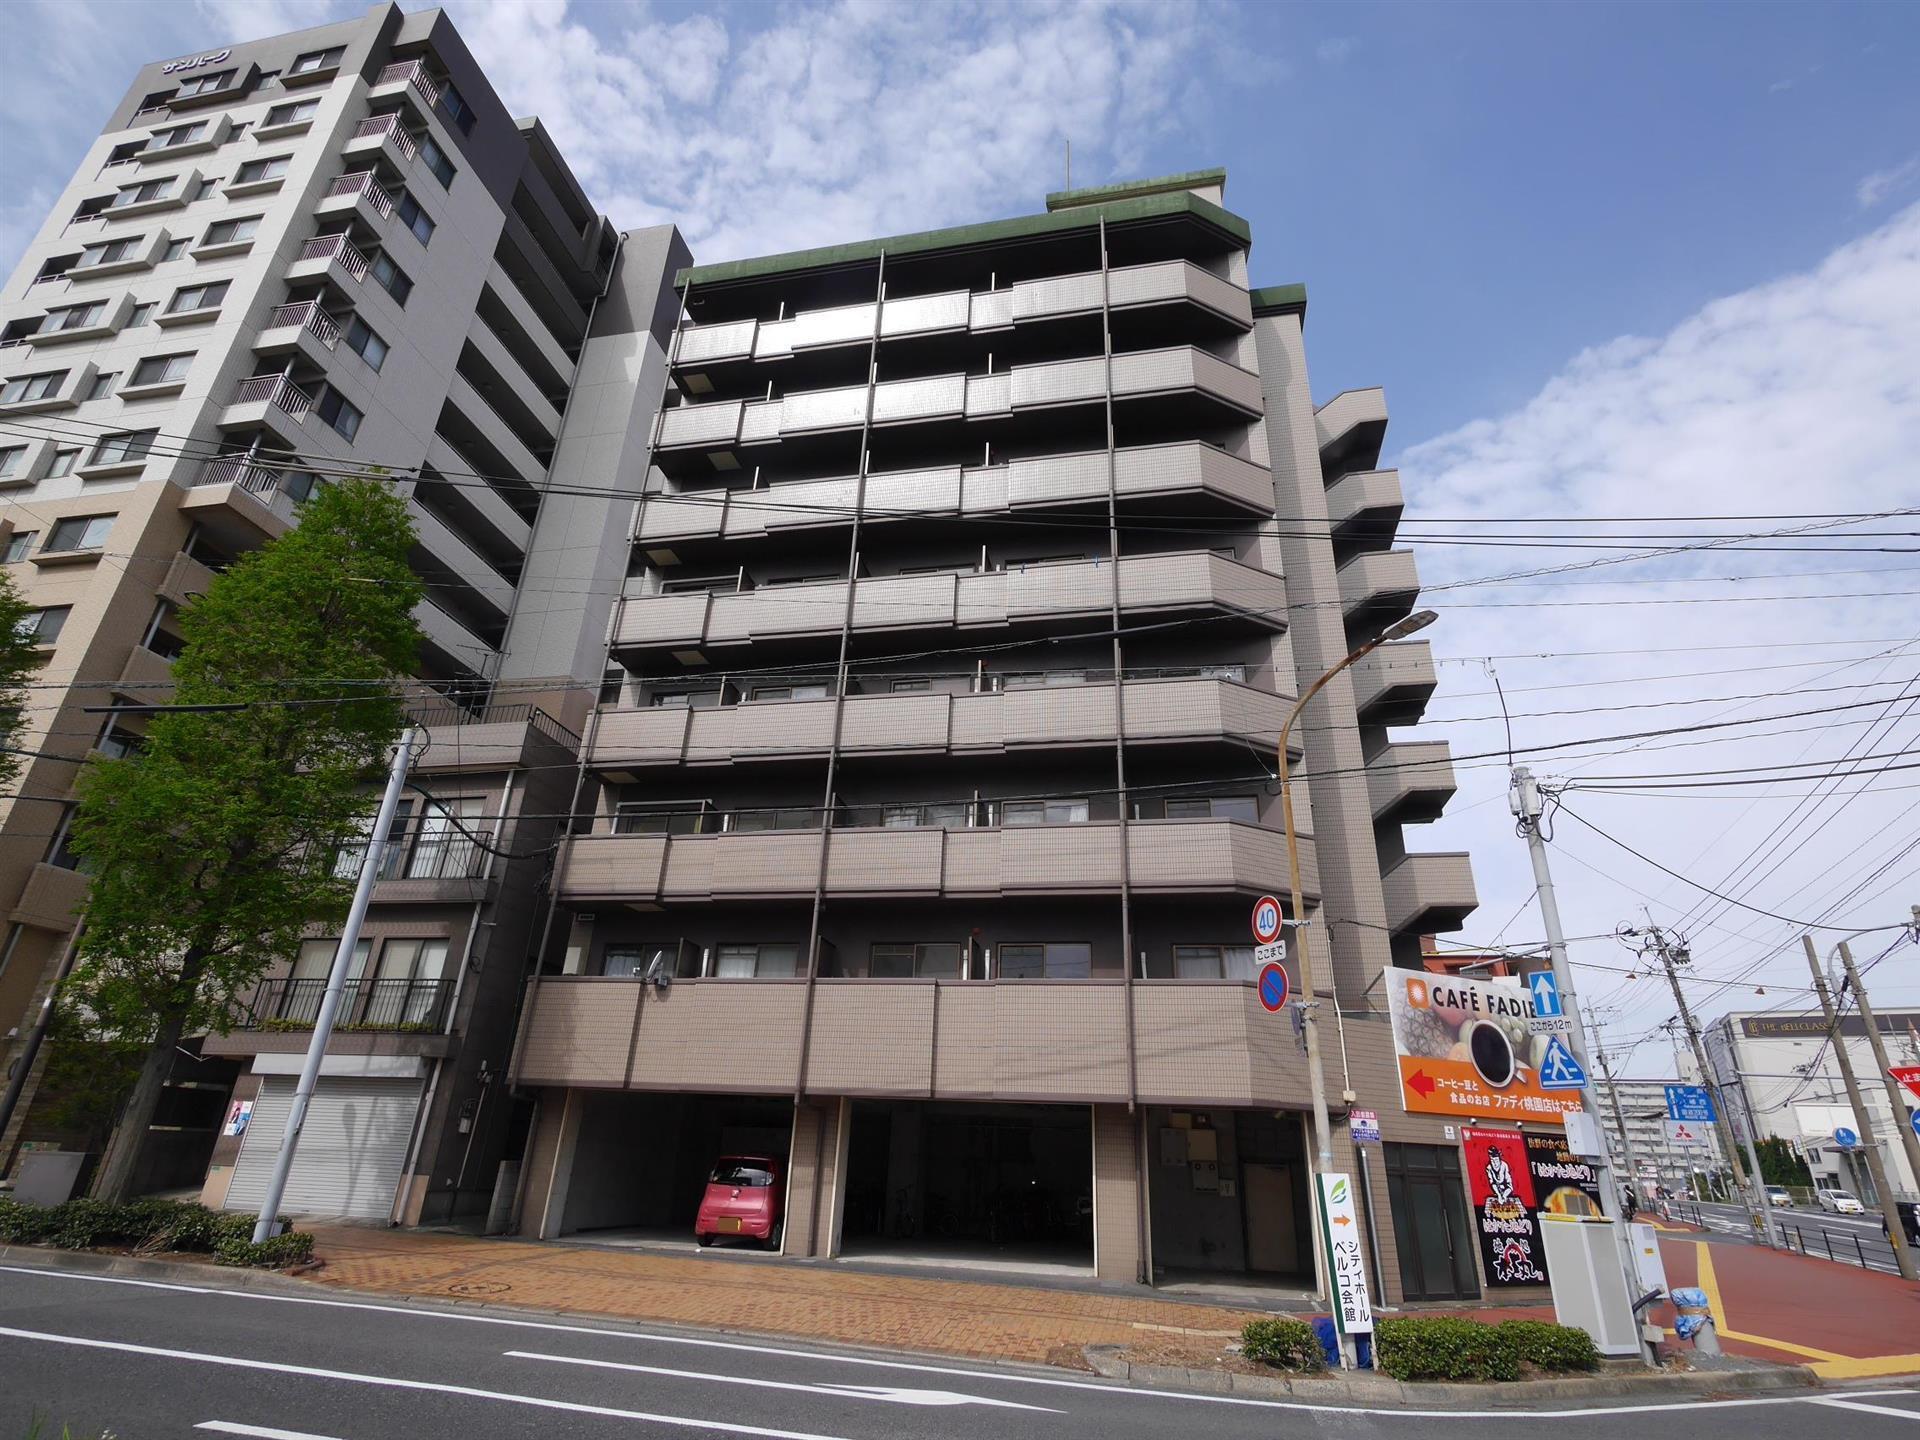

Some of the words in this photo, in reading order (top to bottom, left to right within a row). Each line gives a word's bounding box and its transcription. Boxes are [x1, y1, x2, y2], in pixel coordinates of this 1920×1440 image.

[1260, 908, 1275, 930] 40
[1257, 946, 1283, 961] ここまで
[1432, 986, 1480, 1012] CAFÉ
[1436, 1078, 1479, 1090] コーヒー豆と
[1450, 1092, 1490, 1107] 食品のお店
[1334, 1241, 1357, 1322] ベルコ会館
[1348, 1241, 1370, 1323] シティホール
